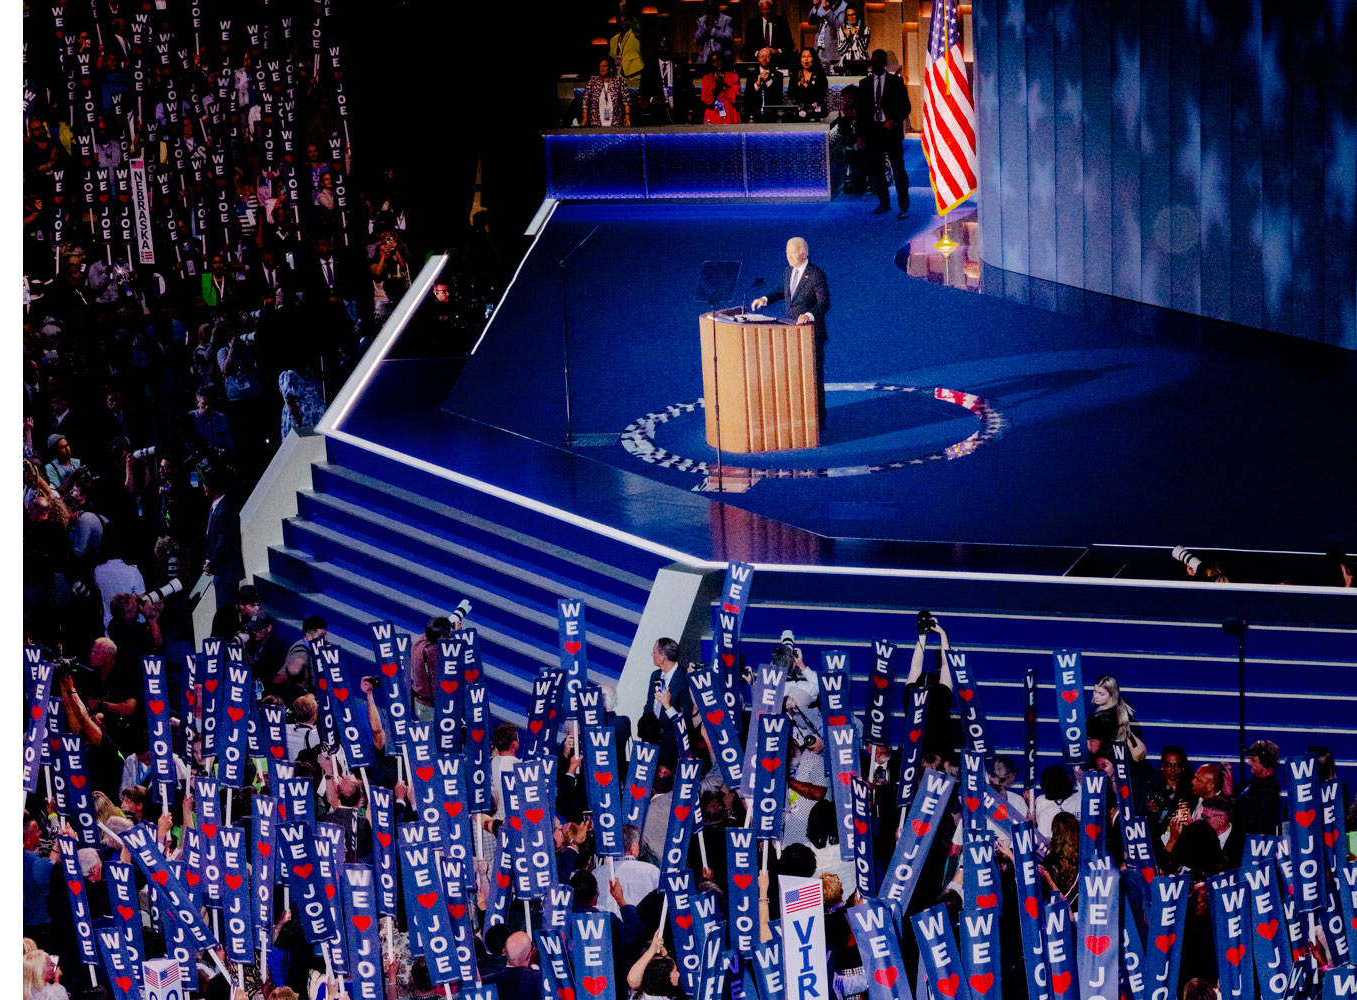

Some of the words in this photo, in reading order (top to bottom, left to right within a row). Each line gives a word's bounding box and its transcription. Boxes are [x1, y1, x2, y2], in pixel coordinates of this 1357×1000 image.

[131, 23, 142, 43] WE
[134, 60, 143, 91] JOE
[329, 47, 339, 67] WE
[337, 84, 347, 115] JOE
[54, 171, 64, 192] WE
[97, 170, 108, 191] WE
[282, 131, 293, 151] WE
[289, 168, 298, 199] JOE
[329, 139, 340, 159] WE
[336, 175, 346, 206] JOE
[102, 207, 111, 239] JOE
[117, 169, 127, 190] WE
[122, 207, 130, 239] JOE
[134, 171, 150, 249] NEBRASKA
[729, 564, 749, 599] WE
[562, 603, 581, 635] WE
[205, 641, 221, 673] WE
[442, 643, 461, 674] WE
[875, 642, 892, 673] WE
[1057, 654, 1076, 685] WE
[229, 667, 247, 701] WE
[914, 690, 928, 724] WE
[948, 653, 968, 684] WE
[967, 707, 986, 752] JOE
[144, 660, 162, 694] WE
[153, 721, 169, 774] JOE
[205, 699, 216, 748] JOE
[440, 700, 455, 748] JOE
[692, 672, 716, 706] WE
[718, 729, 742, 780] JOE
[763, 717, 784, 752] WE
[871, 695, 884, 738] JOE
[1066, 709, 1081, 758] JOE
[226, 728, 240, 779] JOE
[903, 748, 916, 798] JOE
[62, 736, 80, 768] WE
[77, 796, 95, 843] JOE
[590, 731, 610, 765] WE
[600, 793, 616, 846] JOE
[760, 778, 777, 831] JOE
[921, 776, 949, 815] WE
[1291, 759, 1315, 802] WE
[518, 765, 540, 802] WE
[532, 831, 550, 887] JOE
[731, 832, 751, 868] WE
[220, 832, 240, 868] WE
[230, 898, 246, 954] JOE
[281, 825, 307, 859] WE
[303, 884, 324, 933] JOE
[346, 869, 373, 908] WE
[888, 846, 919, 904] JOE
[1299, 836, 1319, 900] JOE
[59, 841, 77, 875] WE
[76, 903, 95, 963] JOE
[405, 847, 432, 887] WE
[428, 914, 452, 974] JOE
[737, 896, 753, 951] JOE
[1084, 876, 1113, 925] WE
[1222, 888, 1244, 938] WE
[101, 933, 125, 970] WE
[855, 907, 891, 959] WE
[1046, 910, 1066, 963] WE
[358, 939, 376, 999] JOE
